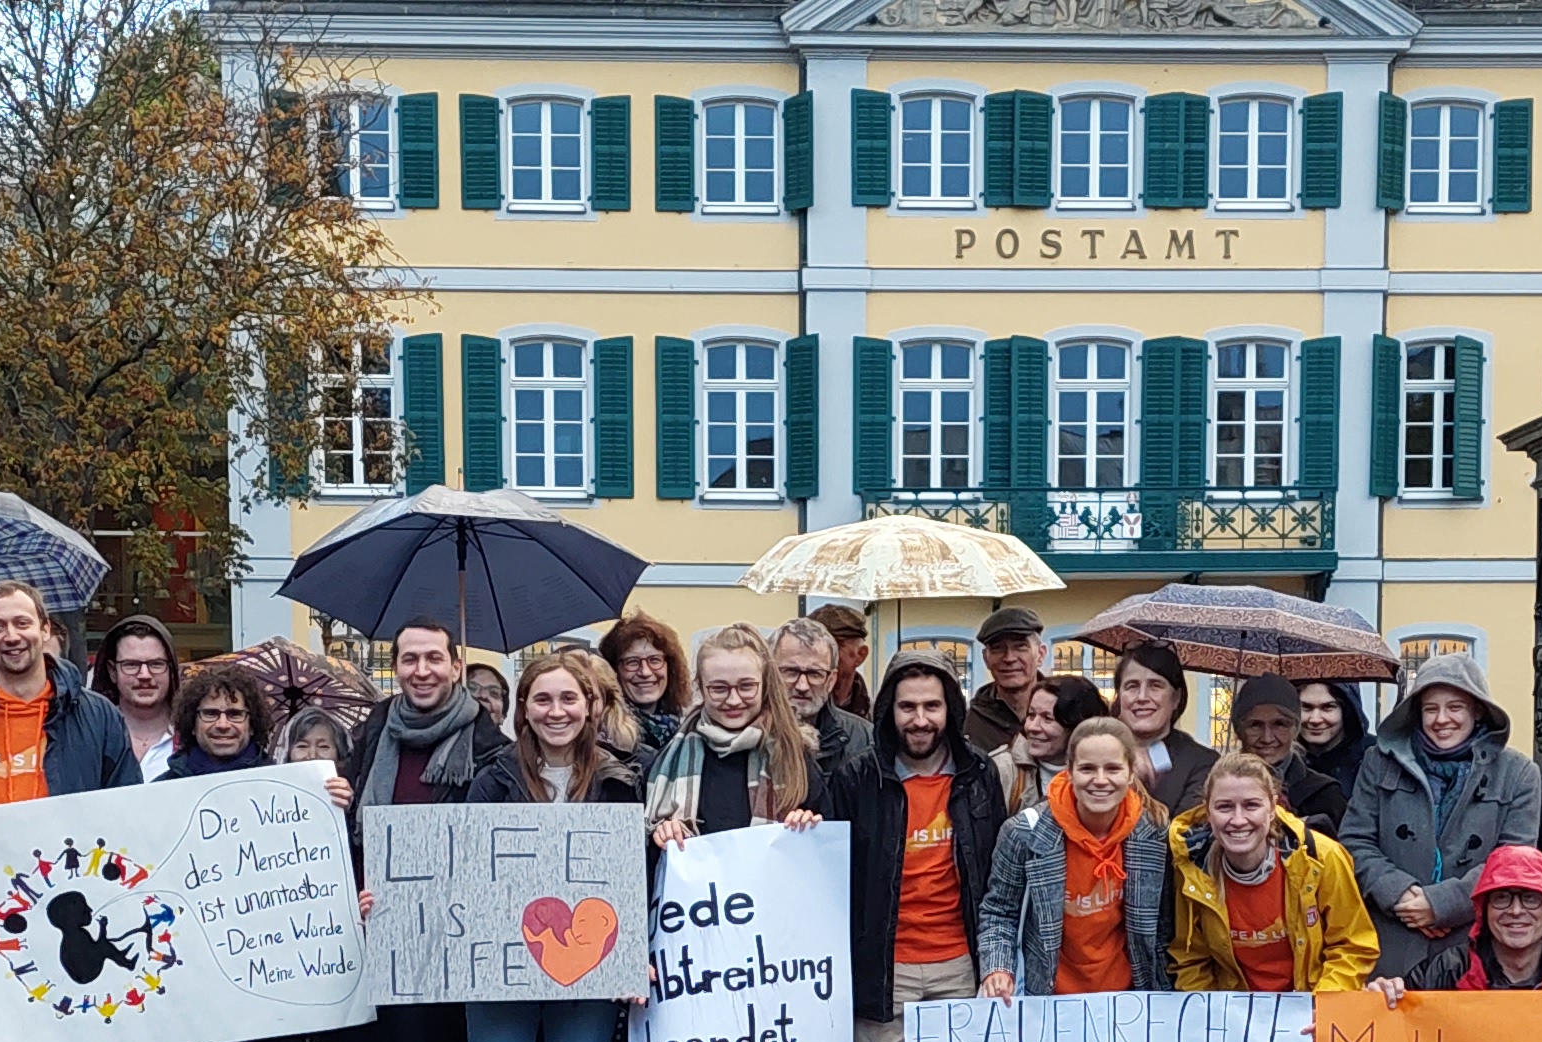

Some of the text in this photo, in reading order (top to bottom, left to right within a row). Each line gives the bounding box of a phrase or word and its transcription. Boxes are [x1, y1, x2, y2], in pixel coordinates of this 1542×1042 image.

[953, 228, 1240, 259] POSTAMT
[199, 795, 310, 840] Die Würde
[913, 827, 953, 841] IS LIF
[185, 831, 330, 890] des Menschen
[386, 824, 611, 883] LIFE
[197, 897, 226, 923] ist
[1077, 894, 1092, 909] IS
[289, 910, 344, 940] Würde
[419, 902, 465, 937] IS
[249, 957, 295, 988] Meine
[391, 941, 530, 996] LIFE
